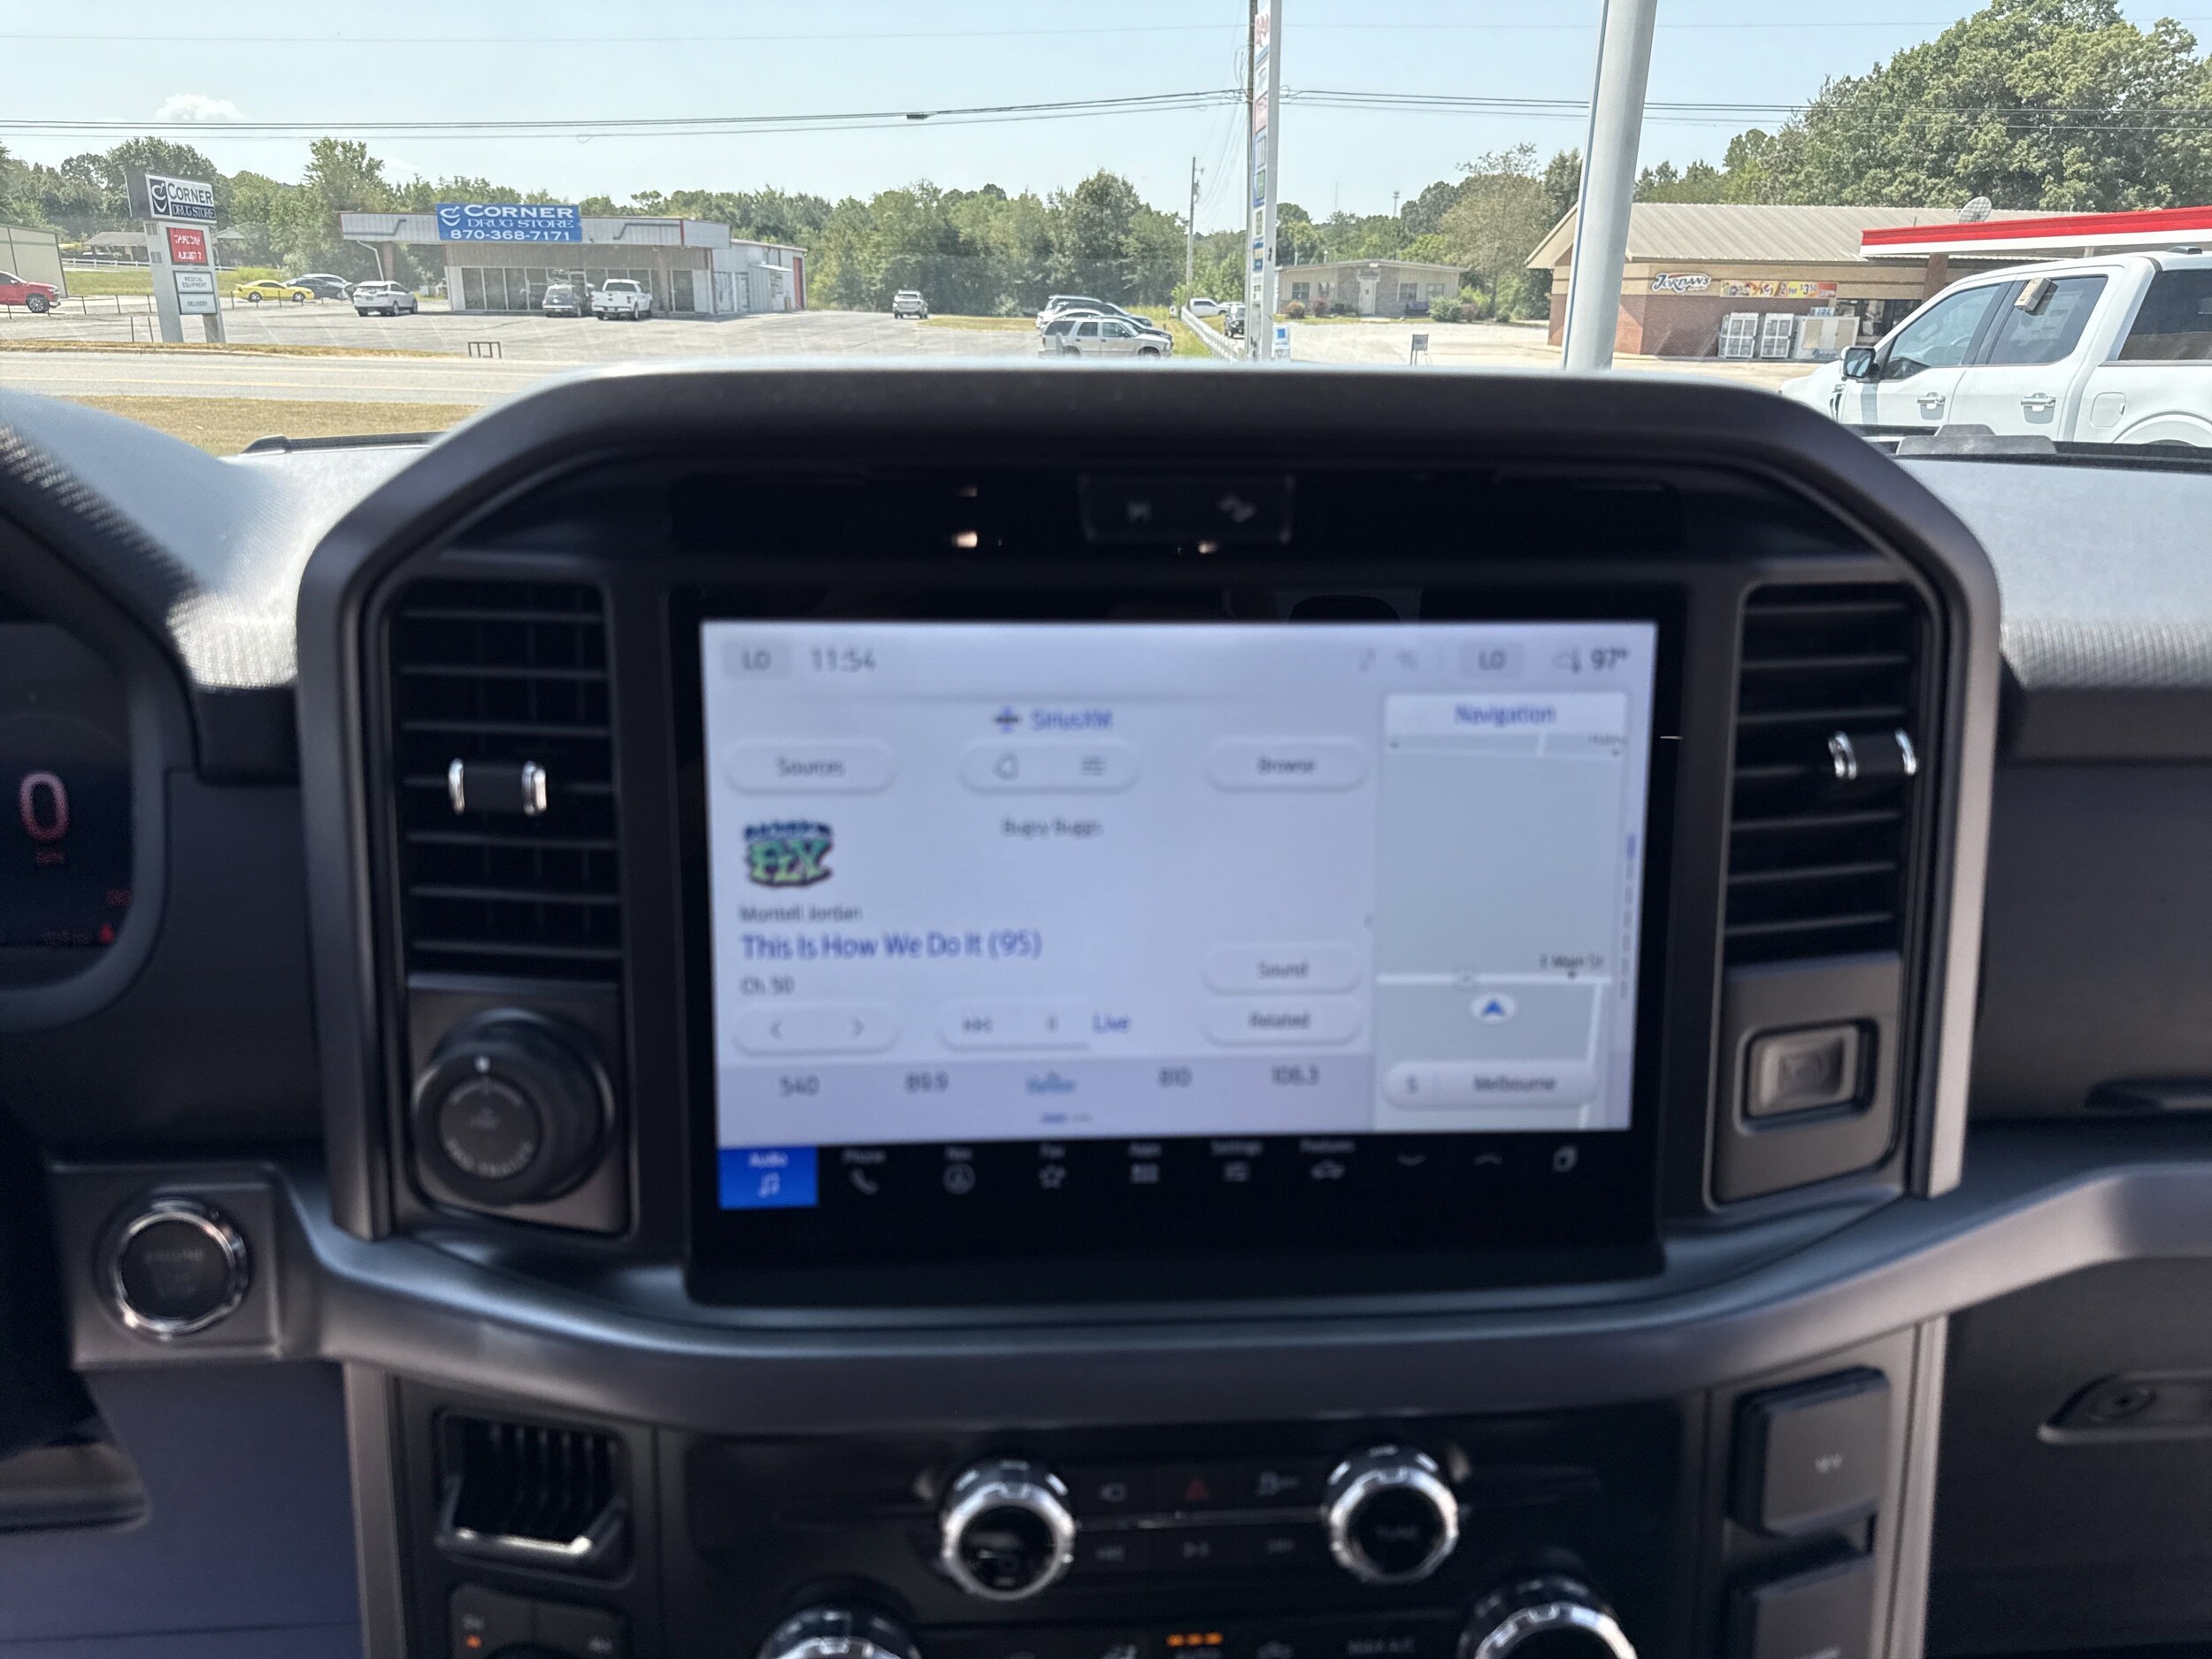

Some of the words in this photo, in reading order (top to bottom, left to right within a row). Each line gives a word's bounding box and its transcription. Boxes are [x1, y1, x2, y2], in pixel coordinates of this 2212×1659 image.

[167, 182, 213, 205] CORNER
[172, 204, 191, 217] DRUG
[192, 206, 215, 219] STORE
[464, 204, 573, 219] CORNER
[467, 219, 513, 227] DRUG
[518, 219, 574, 228] STORE
[450, 229, 570, 241] 870-368-7171
[1780, 283, 1786, 295] 2
[741, 649, 771, 672] LO
[810, 648, 876, 672] 11:54
[1479, 649, 1508, 671] LO
[1031, 708, 1112, 731] SiriusXM
[1455, 704, 1555, 727] Navigation
[777, 757, 846, 777] Sources
[1257, 757, 1317, 774] Browse
[19, 771, 69, 841] 0
[740, 904, 803, 922] Montell
[807, 904, 861, 922] Jordan
[741, 933, 793, 960] This
[799, 933, 818, 959] Is
[822, 933, 879, 959] How
[884, 932, 922, 958] We
[926, 932, 961, 957] Do
[964, 931, 982, 956] It
[987, 929, 1043, 960] (95)
[1257, 960, 1309, 979] Sound
[1093, 1013, 1131, 1033] Live
[1249, 1010, 1310, 1030] Related
[780, 1074, 820, 1097] 540
[904, 1071, 949, 1093] 89.9
[1473, 1073, 1555, 1093] Melbourne
